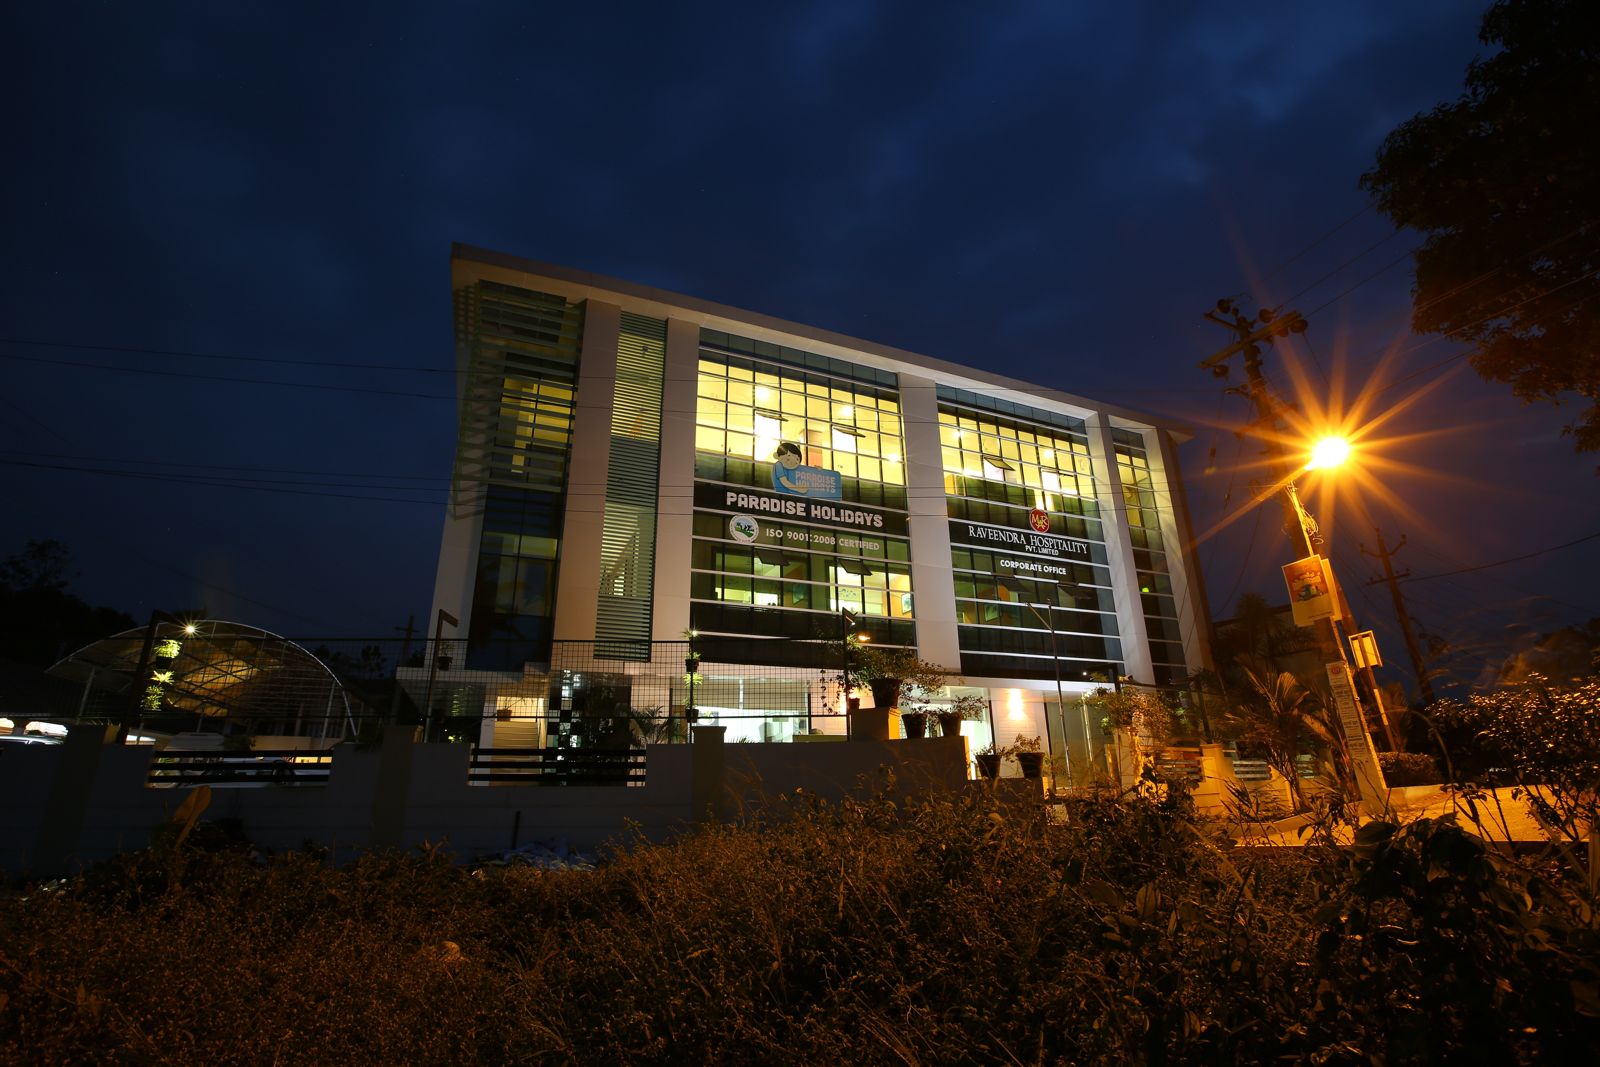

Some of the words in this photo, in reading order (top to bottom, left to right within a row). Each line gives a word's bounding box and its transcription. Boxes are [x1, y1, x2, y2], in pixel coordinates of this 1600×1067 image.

[795, 471, 836, 483] PARADISE
[726, 492, 806, 516] PARADISE
[810, 504, 883, 528] HOLIDAYS
[766, 528, 784, 538] ISO
[787, 531, 836, 545] 9001:2008
[838, 538, 880, 551] CERTIFIED
[968, 525, 1026, 545] RAVEENDRA
[1030, 534, 1088, 554] HOSPITALITY
[1038, 547, 1059, 556] LIMITED
[1000, 559, 1042, 572] CORPORATE
[1043, 565, 1067, 575] OFFICE
